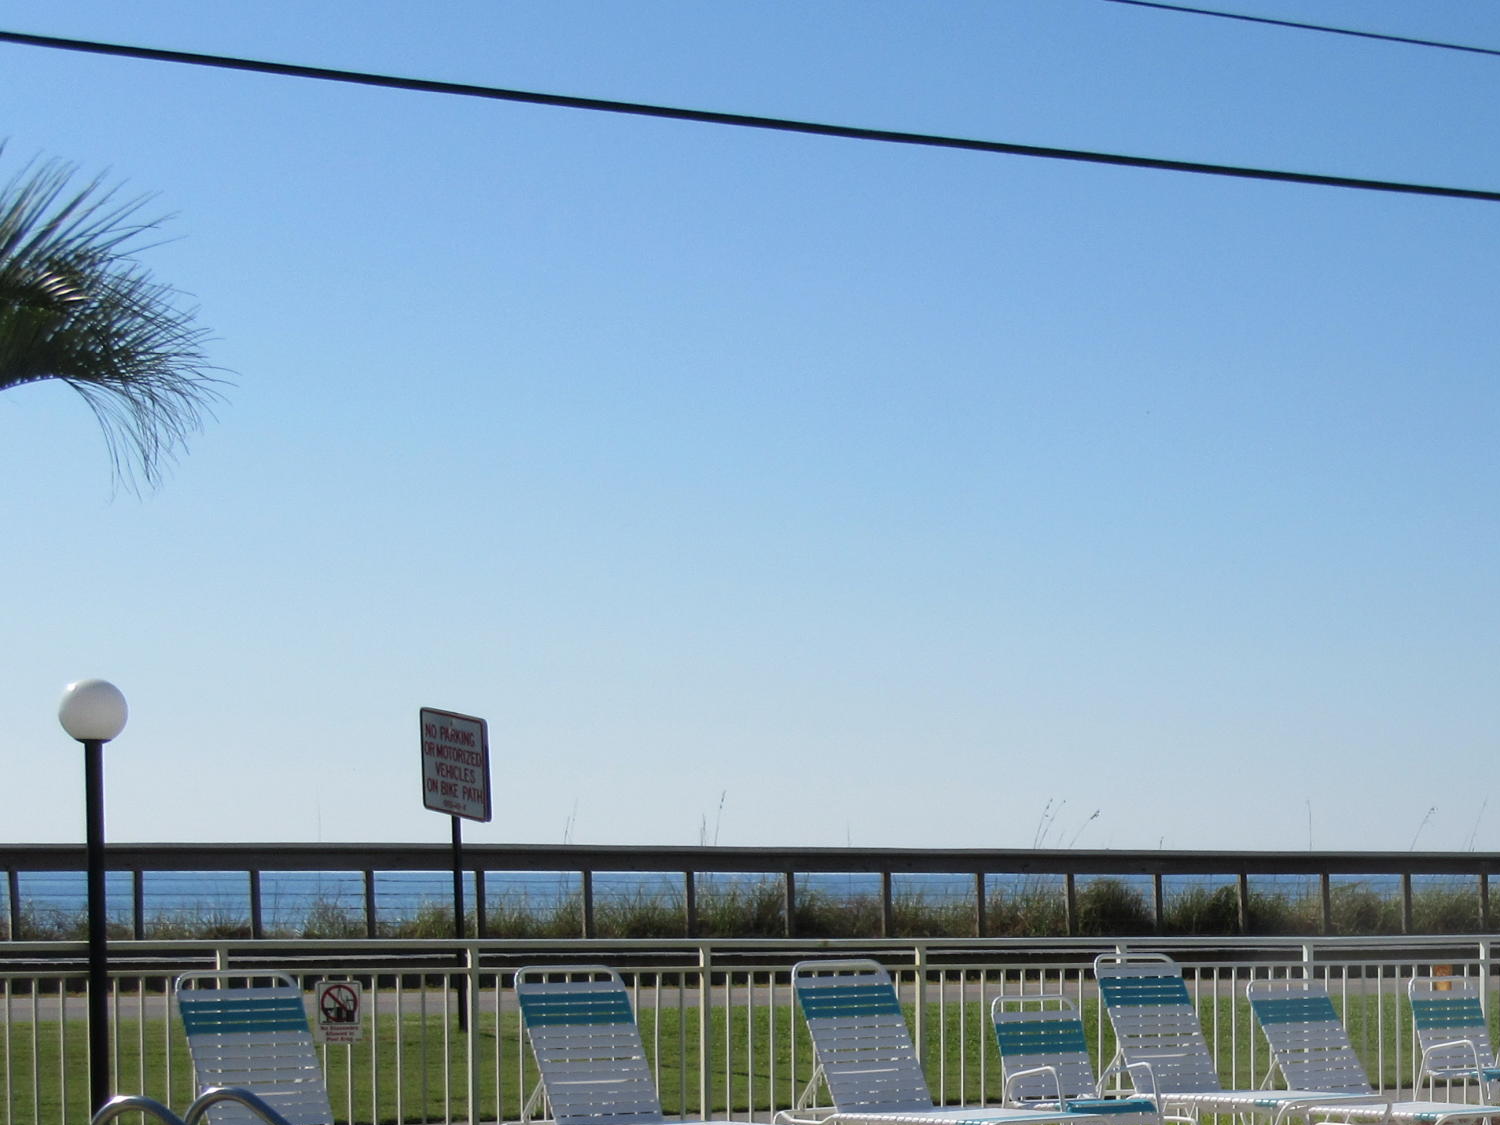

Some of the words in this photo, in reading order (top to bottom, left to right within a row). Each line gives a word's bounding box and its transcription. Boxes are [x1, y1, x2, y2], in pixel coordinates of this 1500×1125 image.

[425, 724, 437, 738] NO
[440, 727, 475, 747] PARKING
[425, 742, 435, 757] OR
[436, 746, 482, 767] MOTORIZED
[436, 762, 475, 784] VEHICLES
[427, 778, 438, 793] ON
[440, 782, 458, 798] BIKE
[463, 786, 484, 804] PATH
